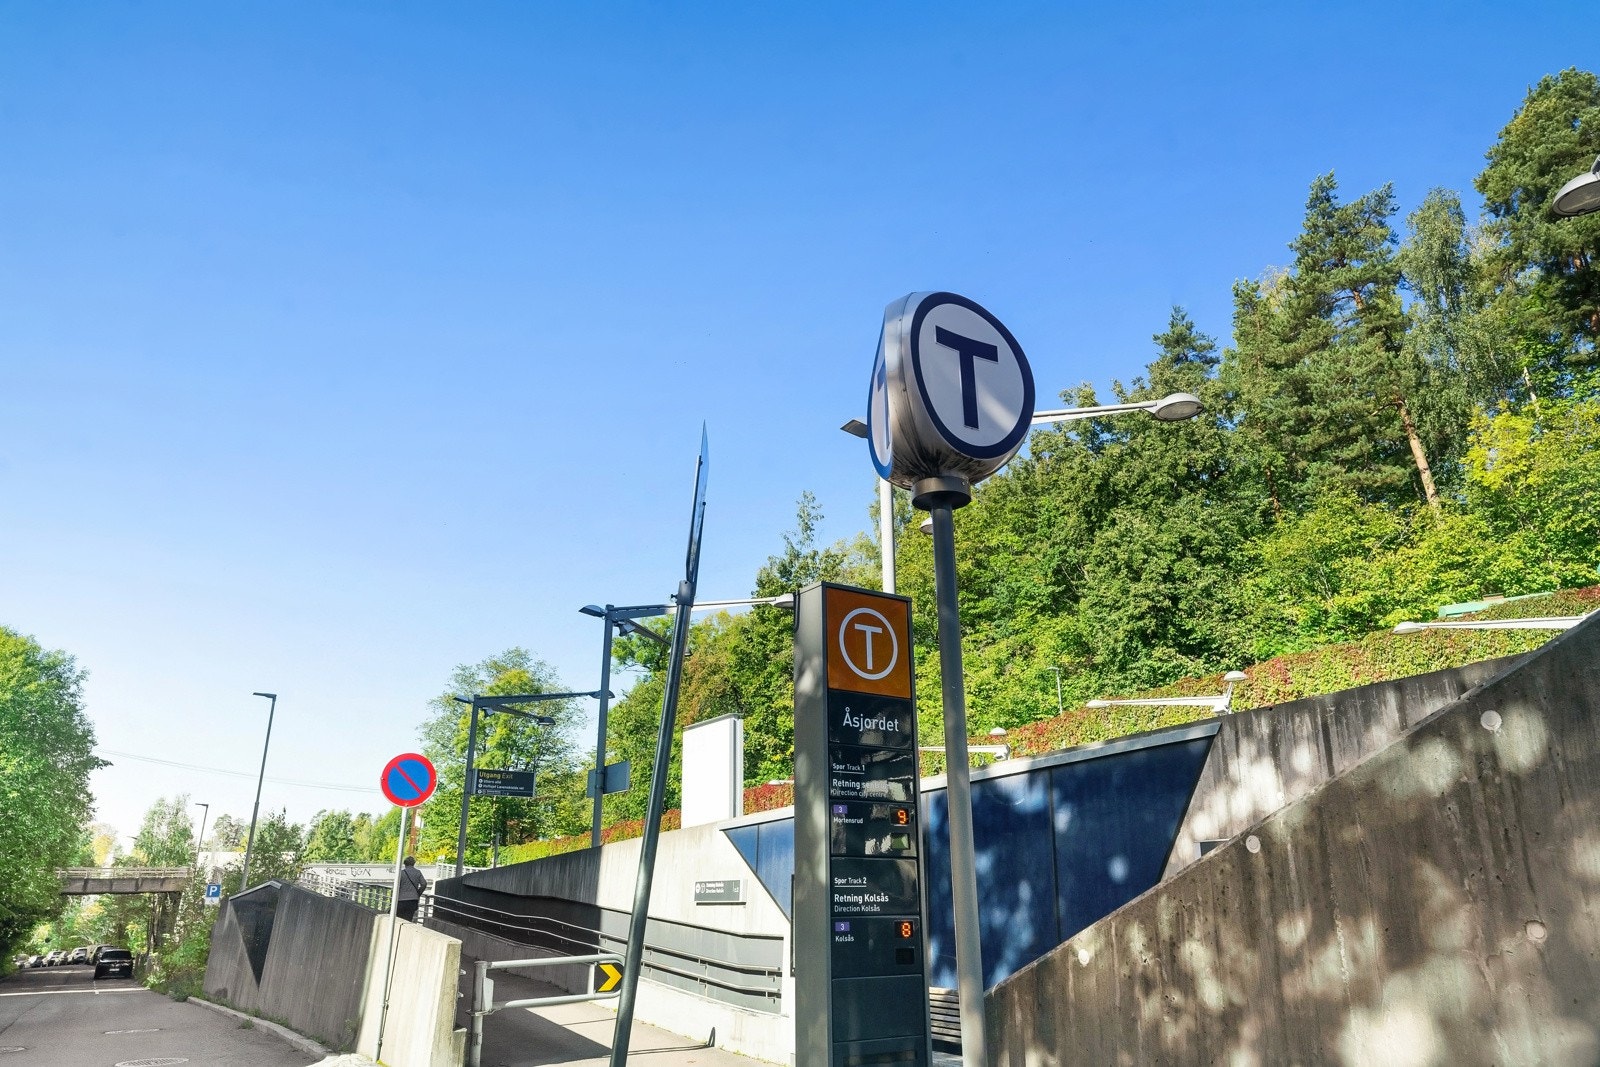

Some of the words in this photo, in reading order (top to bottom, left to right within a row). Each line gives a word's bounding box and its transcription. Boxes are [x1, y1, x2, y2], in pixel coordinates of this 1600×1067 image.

[935, 325, 999, 430] T
[854, 623, 883, 670] T
[842, 706, 899, 732] Åsjordet
[846, 763, 861, 772] Track
[479, 771, 501, 780] Utgang
[832, 778, 861, 790] Retning
[832, 788, 858, 798] Direction
[858, 790, 869, 799] city
[833, 816, 864, 824] Mortensrud
[897, 809, 906, 824] 9
[834, 877, 847, 886] Spor
[862, 876, 867, 884] 2
[209, 885, 218, 896] P
[834, 893, 863, 904] Retning
[864, 892, 889, 903] Kolsås
[861, 904, 881, 912] Kolsås
[840, 923, 845, 931] 3
[902, 922, 911, 938] 8
[835, 934, 855, 942] Kolsås
